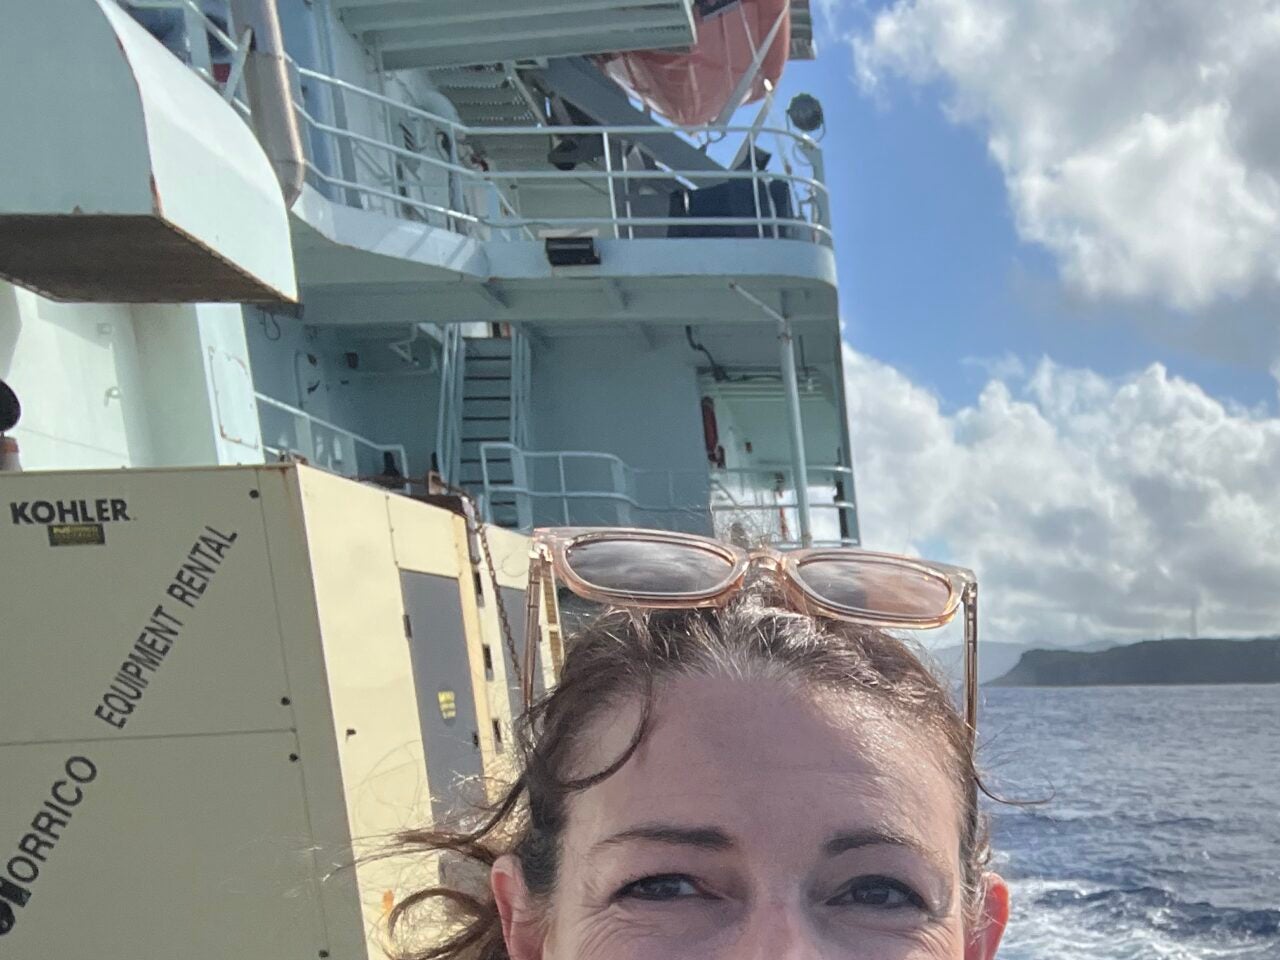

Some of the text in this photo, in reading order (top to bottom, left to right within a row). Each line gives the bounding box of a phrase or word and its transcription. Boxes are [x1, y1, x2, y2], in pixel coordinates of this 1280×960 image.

[10, 498, 130, 524] KOHLER
[95, 604, 184, 729] EQUIPMENT
[166, 525, 238, 608] RENTAL
